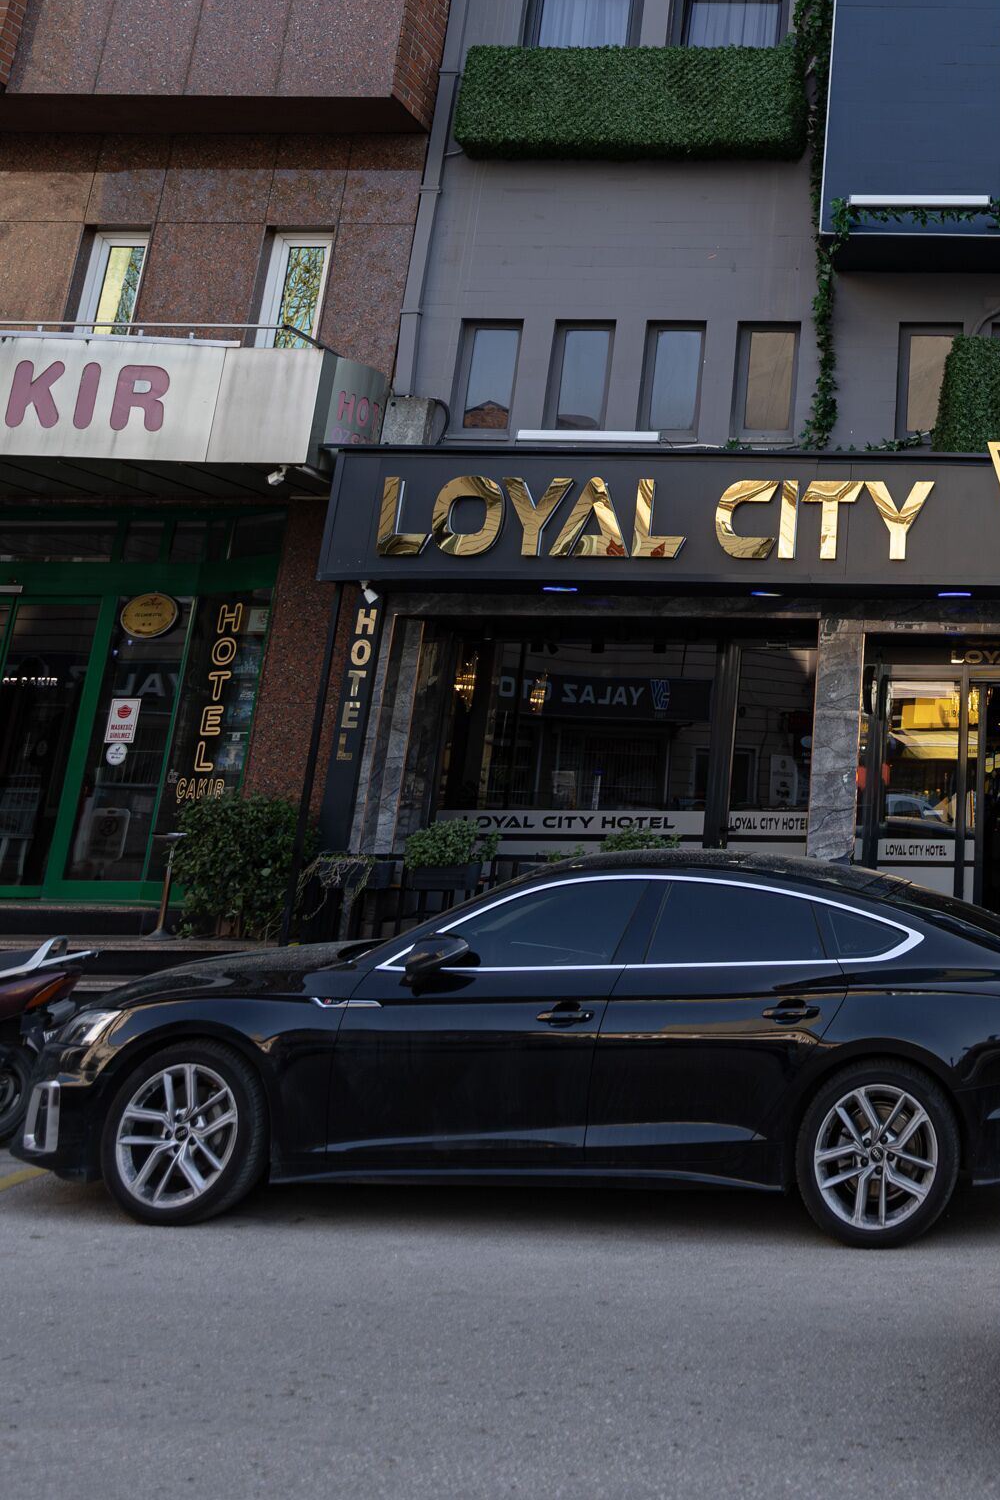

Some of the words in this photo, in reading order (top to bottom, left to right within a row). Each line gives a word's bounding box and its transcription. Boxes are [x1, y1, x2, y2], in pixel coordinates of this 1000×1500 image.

[5, 360, 170, 432] KIR
[376, 475, 688, 559] LOYAL
[714, 479, 936, 560] CITY
[193, 602, 244, 773] HOTEL
[335, 608, 378, 762] HOTEL
[176, 776, 225, 804] ÇAKIR
[463, 815, 536, 829] OYAL
[542, 816, 595, 829] CITY
[601, 816, 676, 829] HOTEL
[729, 817, 758, 831] LOYAL
[760, 818, 781, 831] CITY
[885, 844, 906, 856] LOYAL
[908, 844, 924, 856] CITY
[925, 845, 947, 857] HOTEL
